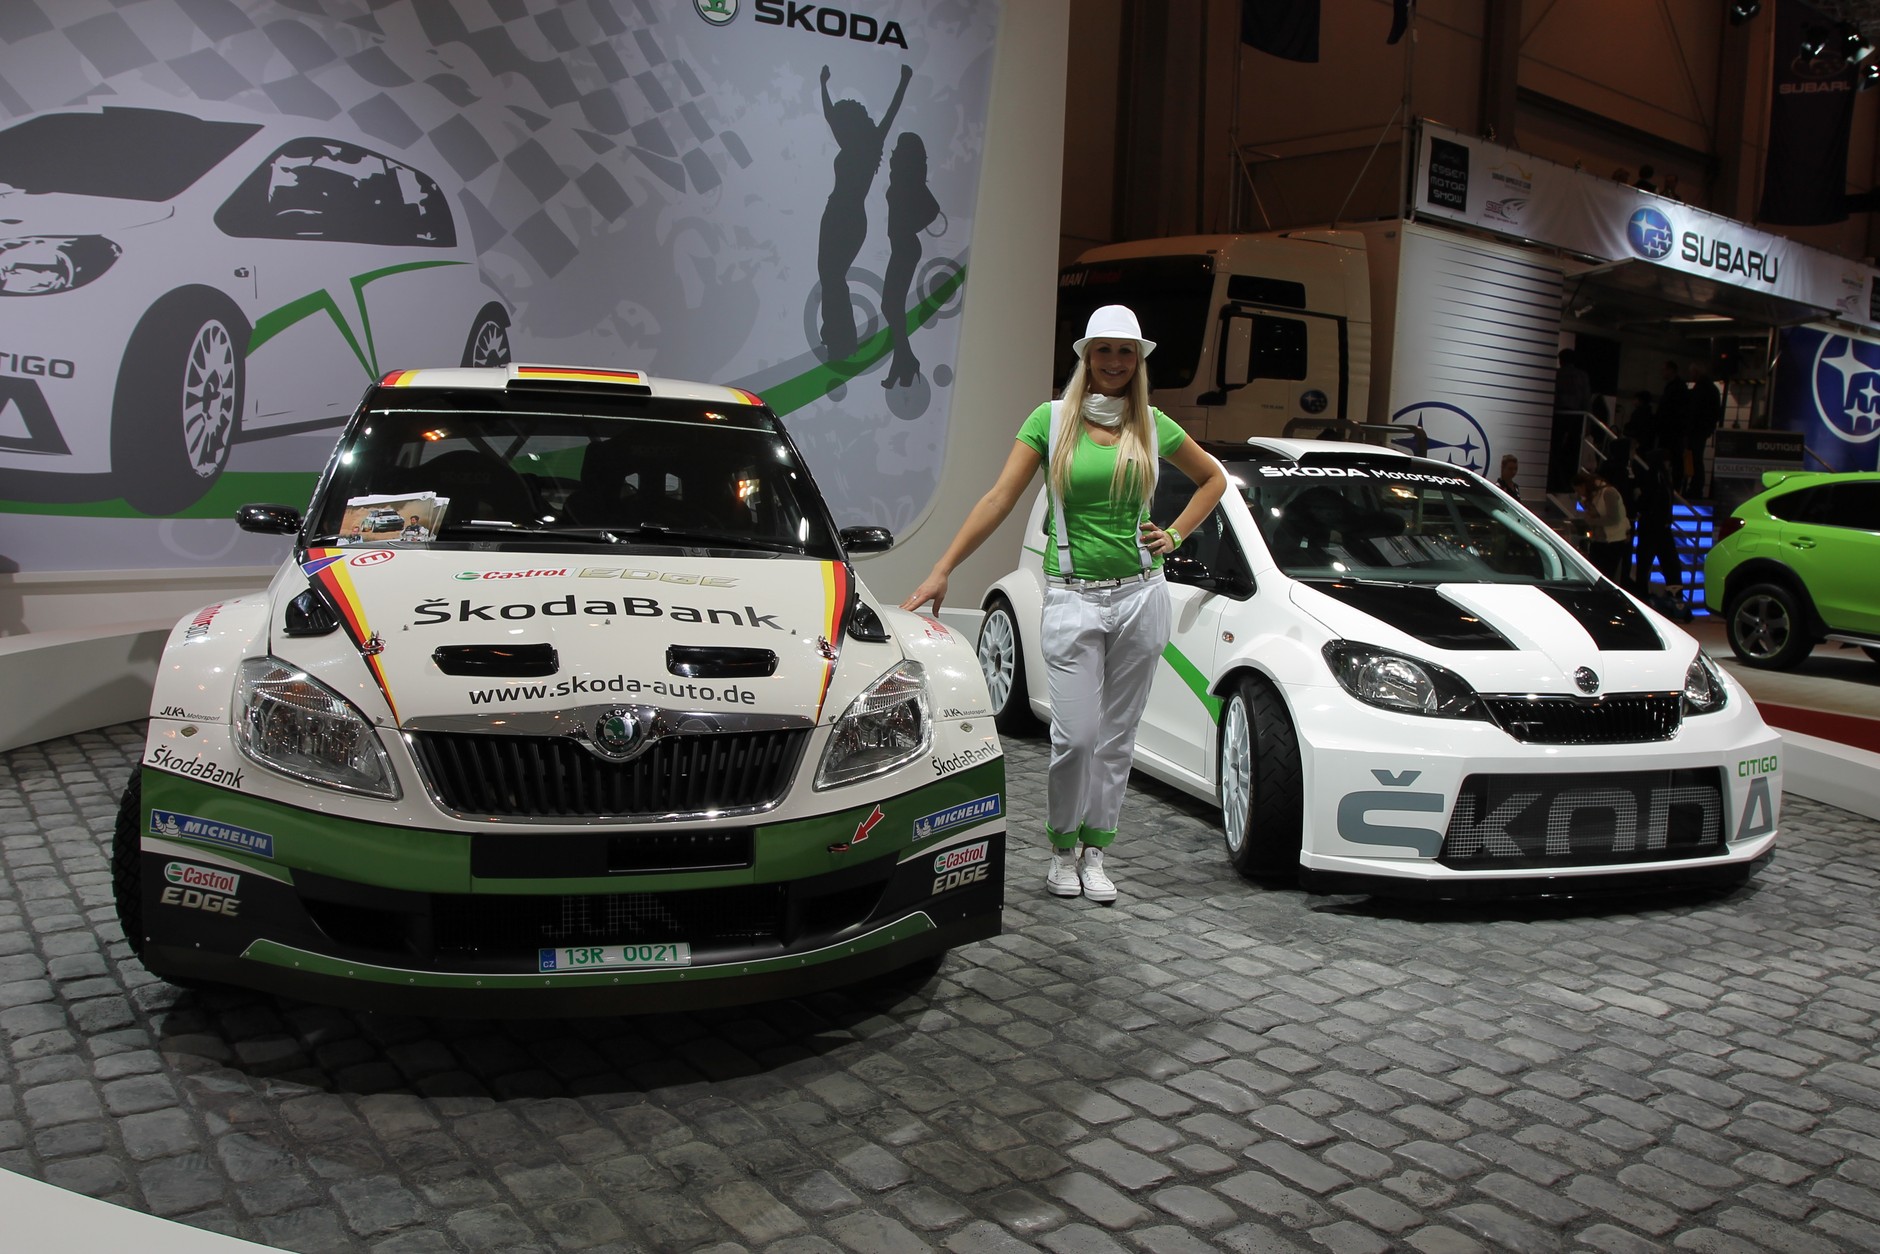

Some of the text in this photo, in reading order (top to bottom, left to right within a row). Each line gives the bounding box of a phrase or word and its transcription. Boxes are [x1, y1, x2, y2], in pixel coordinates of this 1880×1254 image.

[1430, 176, 1466, 192] MOTOR
[1432, 189, 1463, 203] SHOW
[1680, 230, 1779, 284] SUBARU
[1059, 271, 1084, 287] MAN
[1756, 442, 1803, 452] BOUTIQUE
[1258, 465, 1471, 487] ŠKODA Motorsport
[482, 566, 741, 588] Castrol EDGE
[413, 595, 785, 631] ŠkodaBank
[468, 675, 756, 705] www.skoda-auto.de
[186, 713, 221, 721] Motorsport
[148, 744, 245, 789] ŠkodaBank
[932, 741, 1001, 777] ŠkodaBank
[1738, 755, 1778, 778] CITIGO
[933, 799, 996, 829] MICHELIN
[183, 820, 268, 850] MICHELIN
[945, 846, 985, 867] Castrol
[183, 866, 235, 892] Castrol
[931, 862, 991, 895] EDGE
[160, 886, 242, 917] EDGE
[543, 944, 678, 969] CZ 13R 0021
